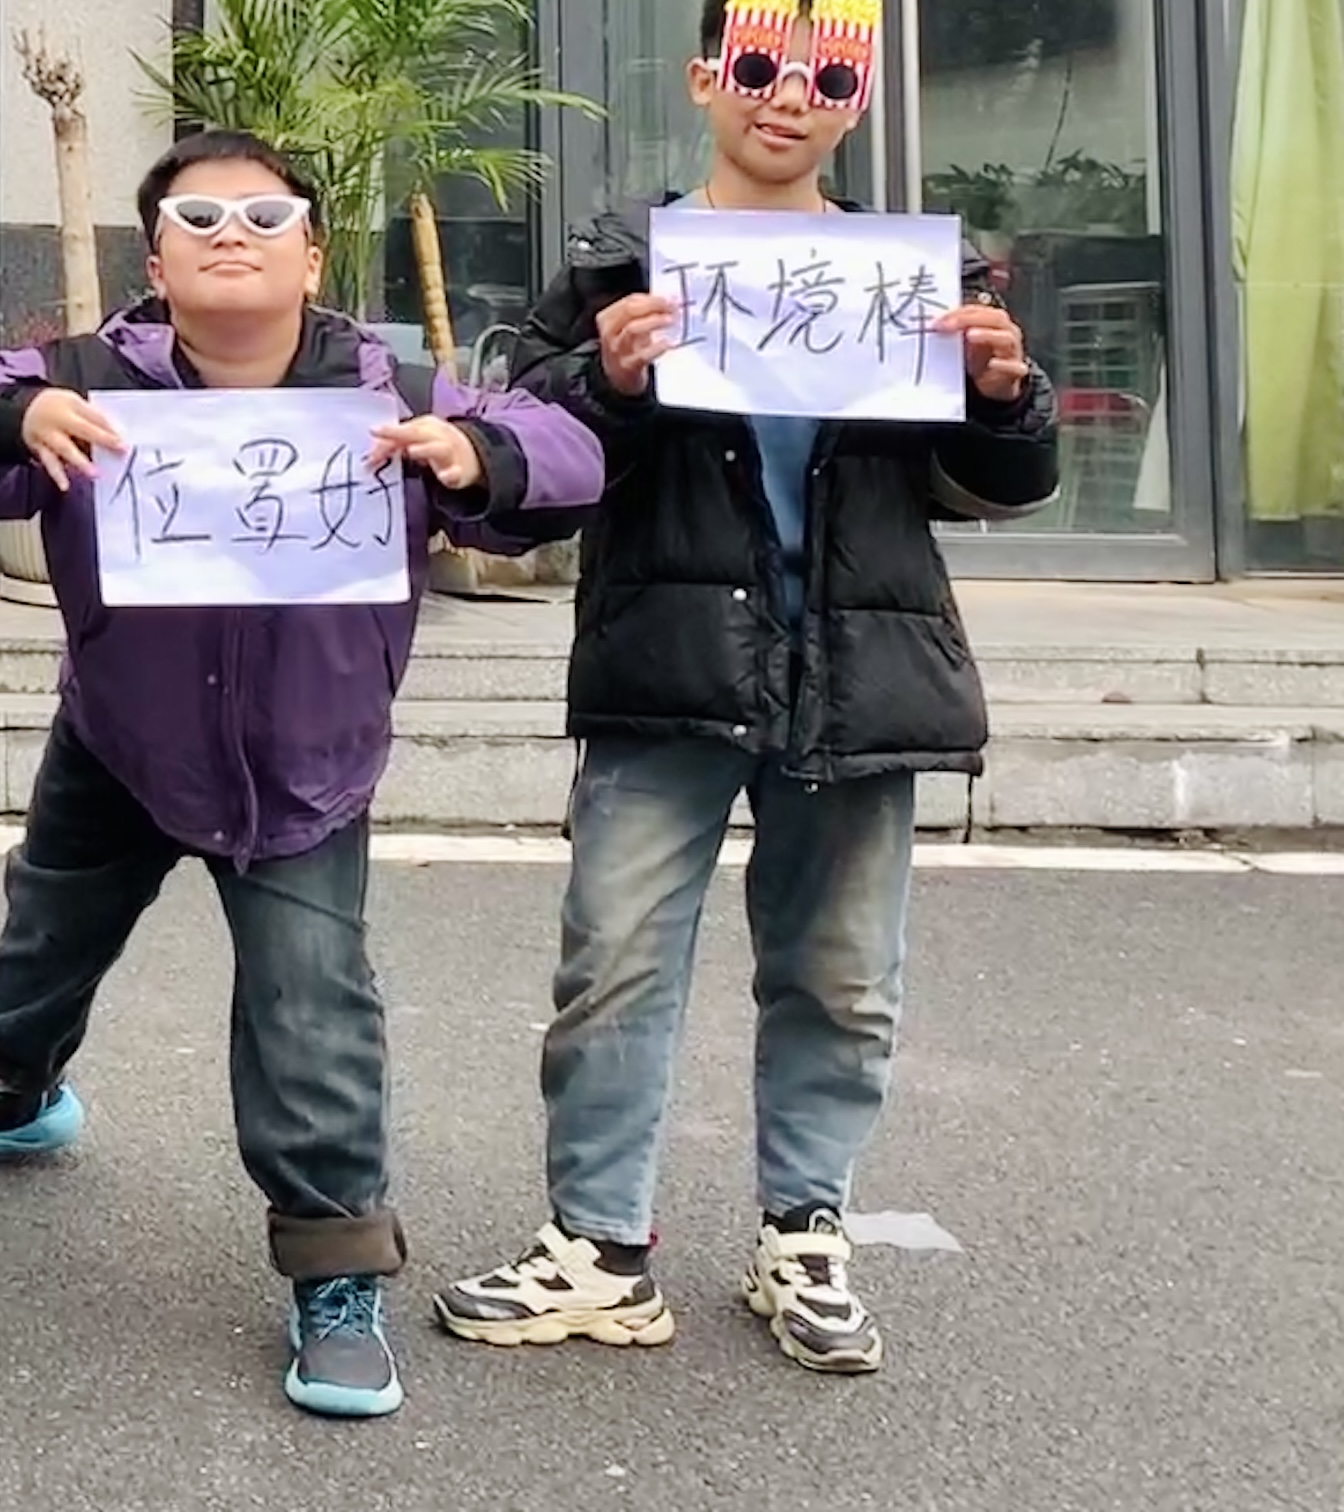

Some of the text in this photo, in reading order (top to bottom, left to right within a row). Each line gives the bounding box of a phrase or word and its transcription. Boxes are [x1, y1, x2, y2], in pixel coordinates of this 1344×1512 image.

[663, 247, 949, 387] 环境棒
[110, 438, 401, 564] 位置好
